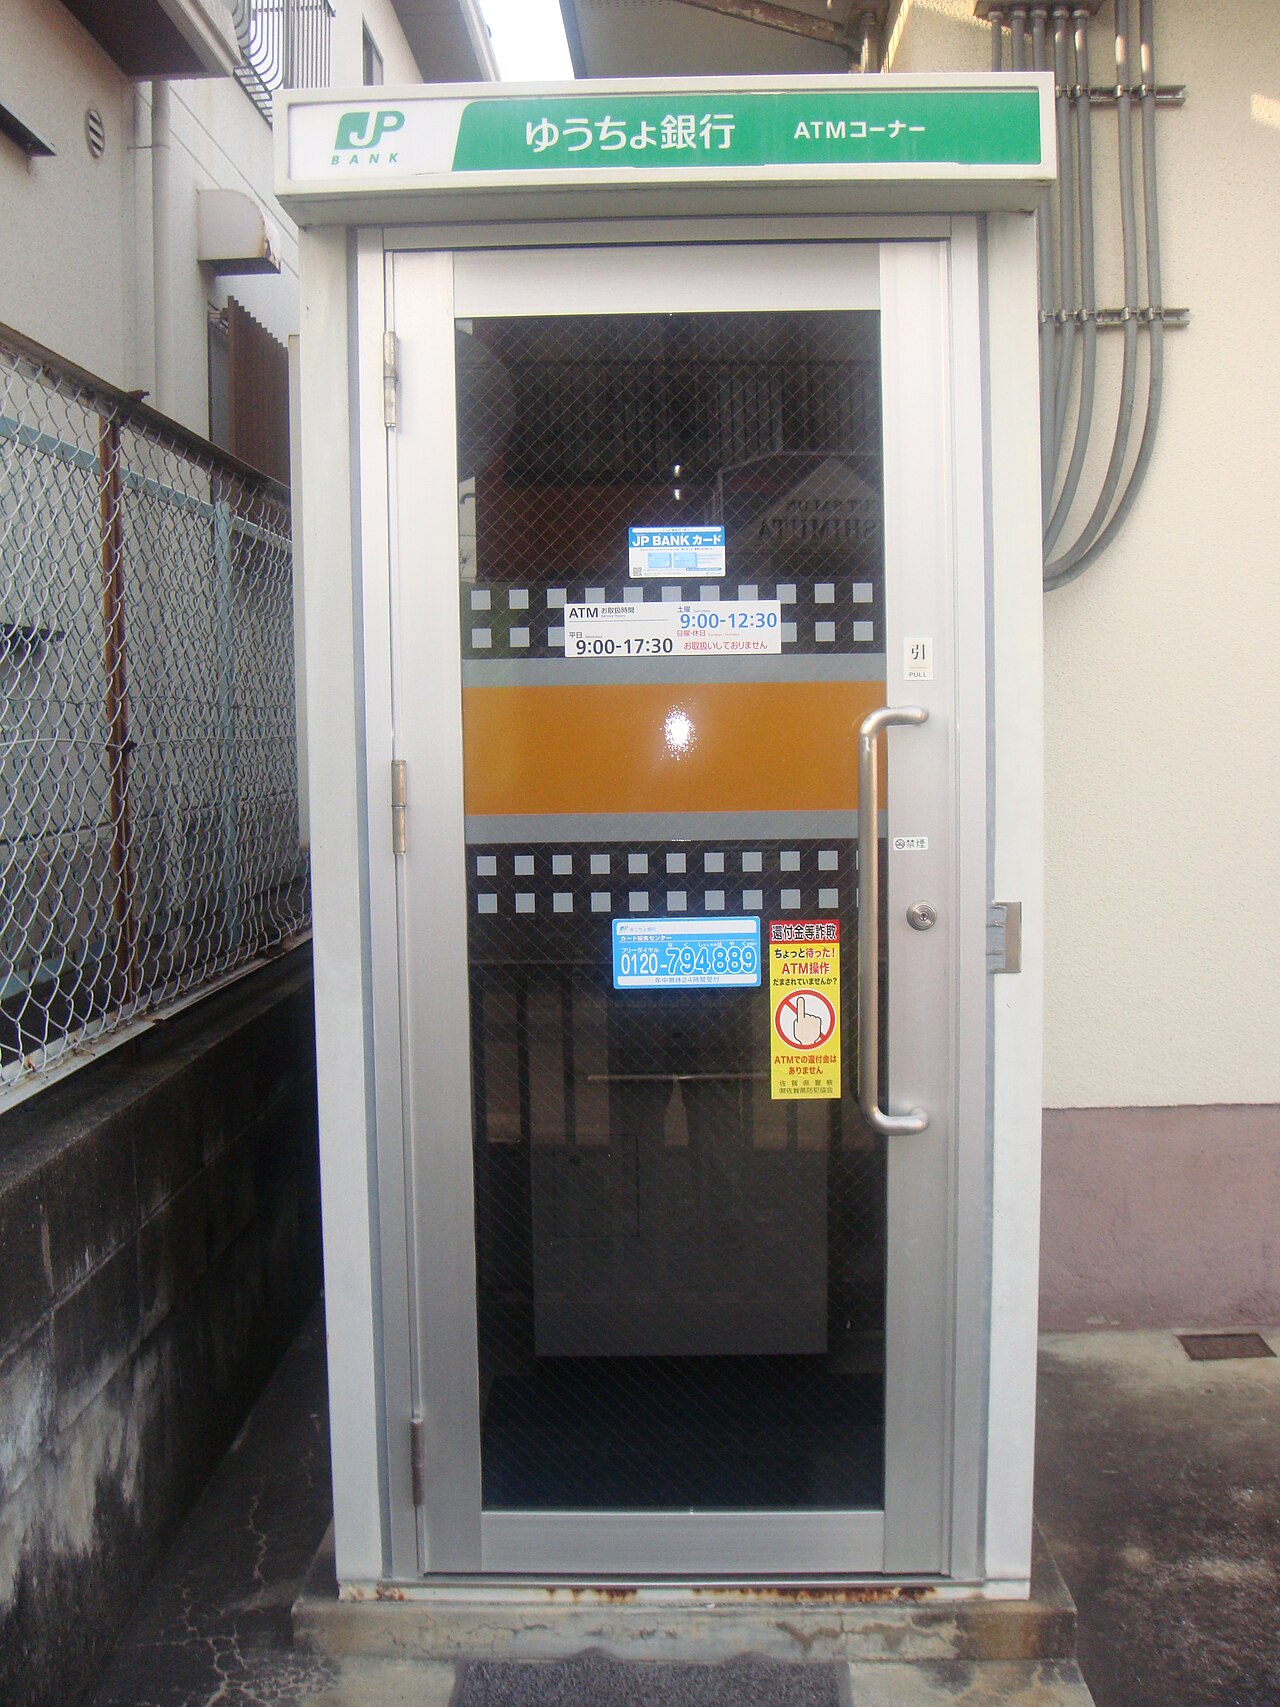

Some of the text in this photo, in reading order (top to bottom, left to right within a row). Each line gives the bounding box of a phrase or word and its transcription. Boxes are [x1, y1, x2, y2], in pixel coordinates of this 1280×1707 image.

[335, 110, 405, 150] JP
[524, 112, 926, 153] ゆうちょ銀行 ATMコーナー
[331, 152, 399, 166] BANK
[632, 534, 722, 547] JP BANK カード
[569, 607, 598, 619] ATM
[680, 612, 778, 629] 9:00-12:30
[569, 631, 583, 639] 平日
[576, 637, 673, 655] 9:00-17:30
[683, 641, 768, 651] お取扱いしておりません
[911, 643, 926, 660] 引
[906, 838, 926, 849] 禁煙
[772, 924, 837, 941] 還付金等詐欺
[781, 962, 830, 975] ATM操作
[774, 1055, 837, 1065] ATMでの還付金は
[788, 1066, 823, 1075] ありません
